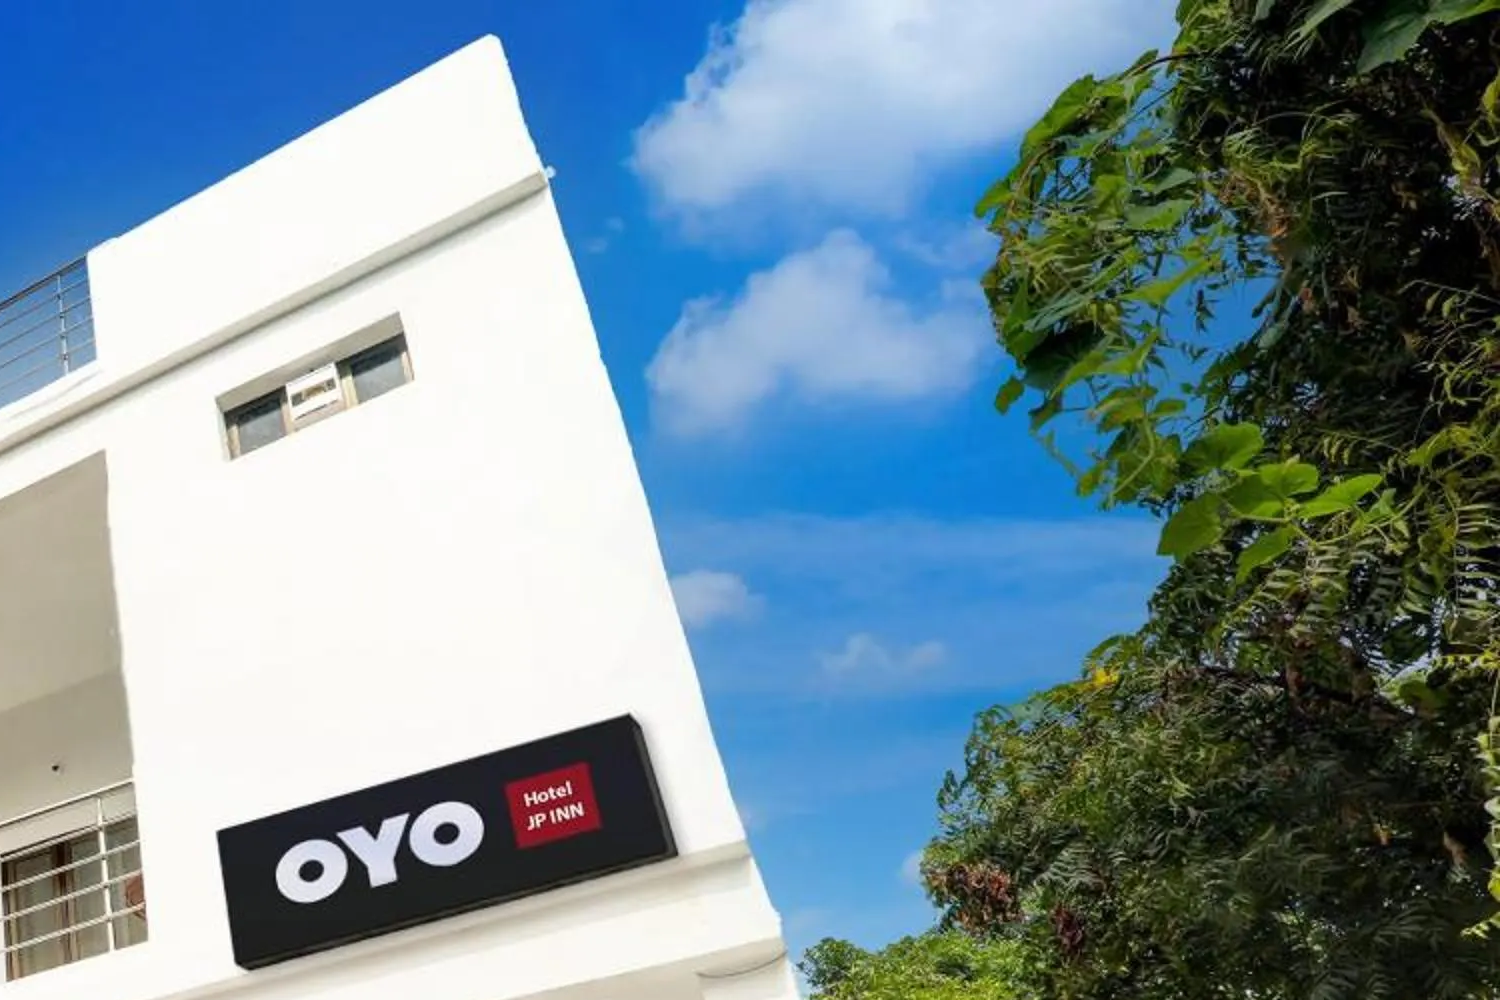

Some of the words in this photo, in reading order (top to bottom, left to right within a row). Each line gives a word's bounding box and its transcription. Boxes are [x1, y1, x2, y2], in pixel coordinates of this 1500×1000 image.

[523, 780, 573, 808] Hotel
[527, 813, 547, 831] JP
[549, 801, 584, 825] INN
[275, 801, 484, 904] OYO
